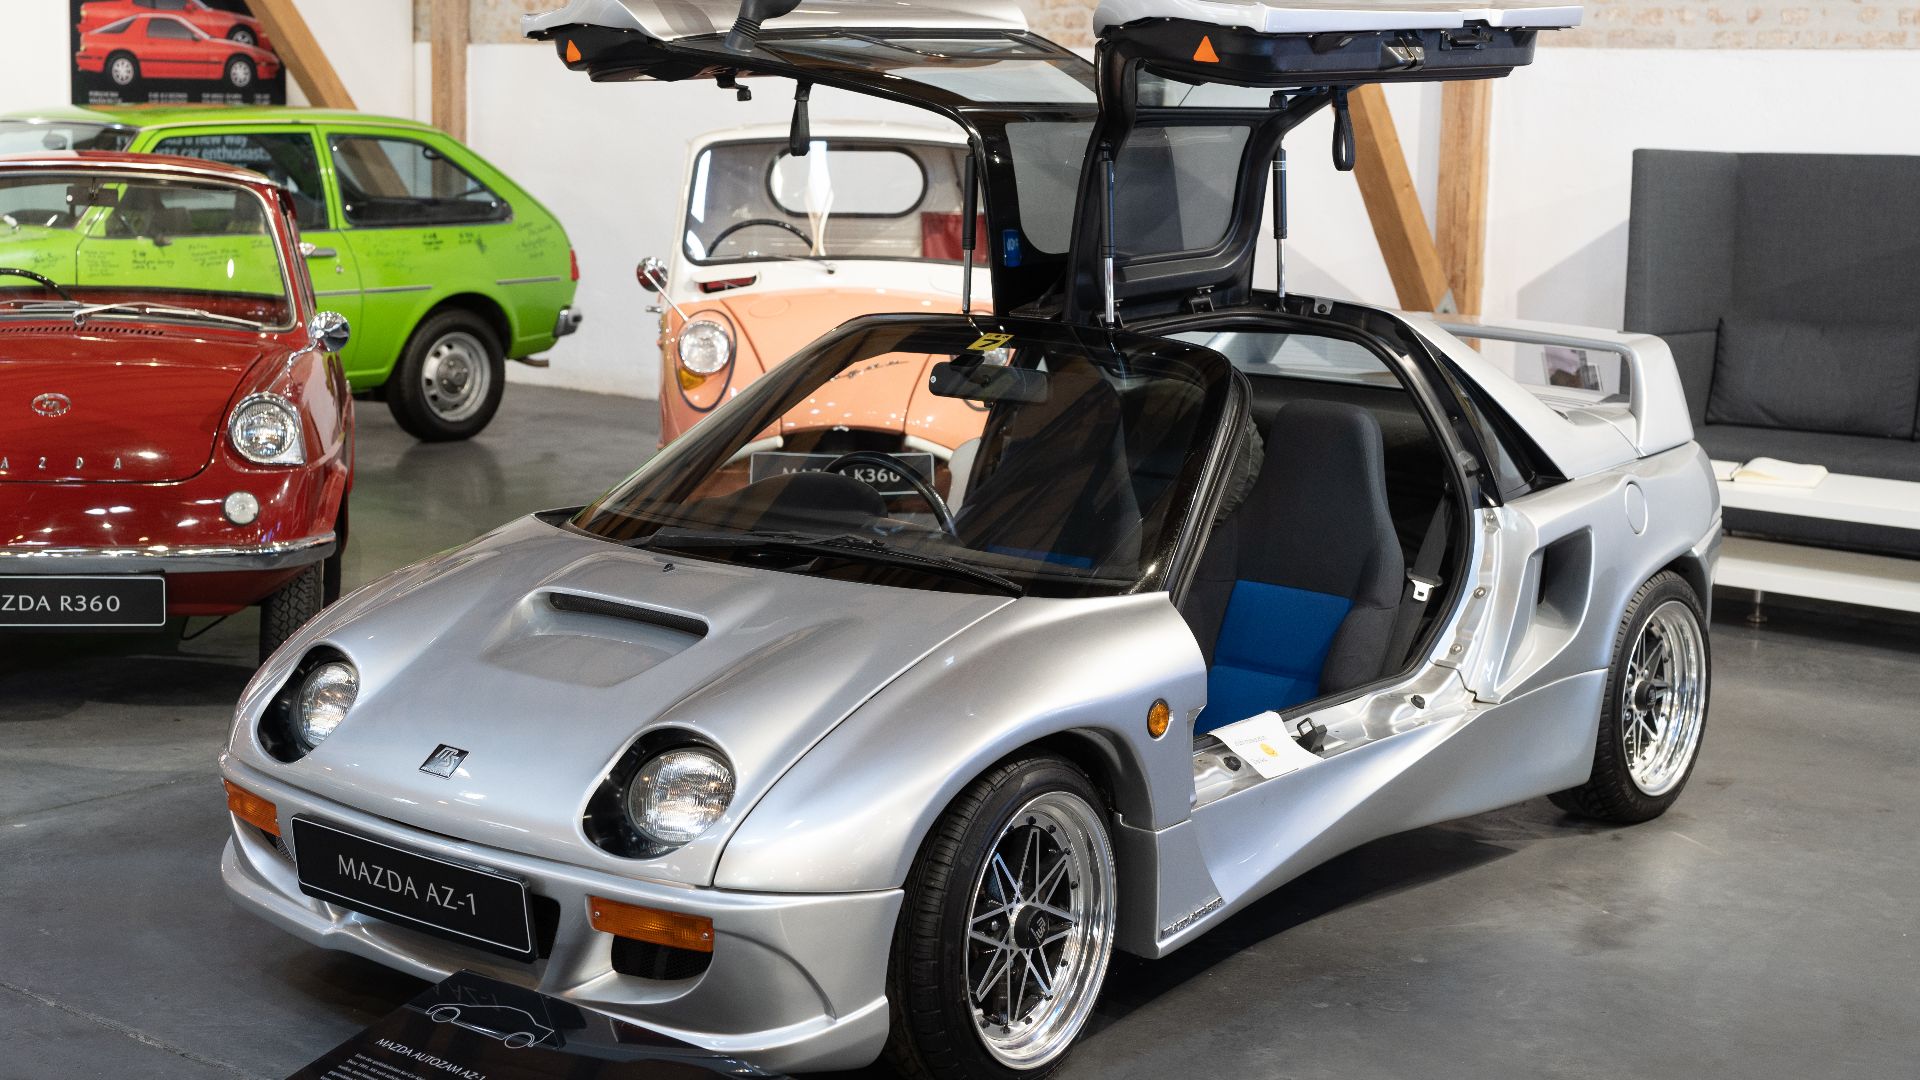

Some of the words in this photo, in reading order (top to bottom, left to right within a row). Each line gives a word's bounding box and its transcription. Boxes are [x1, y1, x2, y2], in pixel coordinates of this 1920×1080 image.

[854, 468, 901, 483] K360
[60, 594, 120, 612] R360
[338, 854, 419, 899] MAZDA
[426, 882, 476, 916] AZ-1
[375, 1038, 413, 1057] MAZDA
[410, 1052, 462, 1075] AUTOZAM
